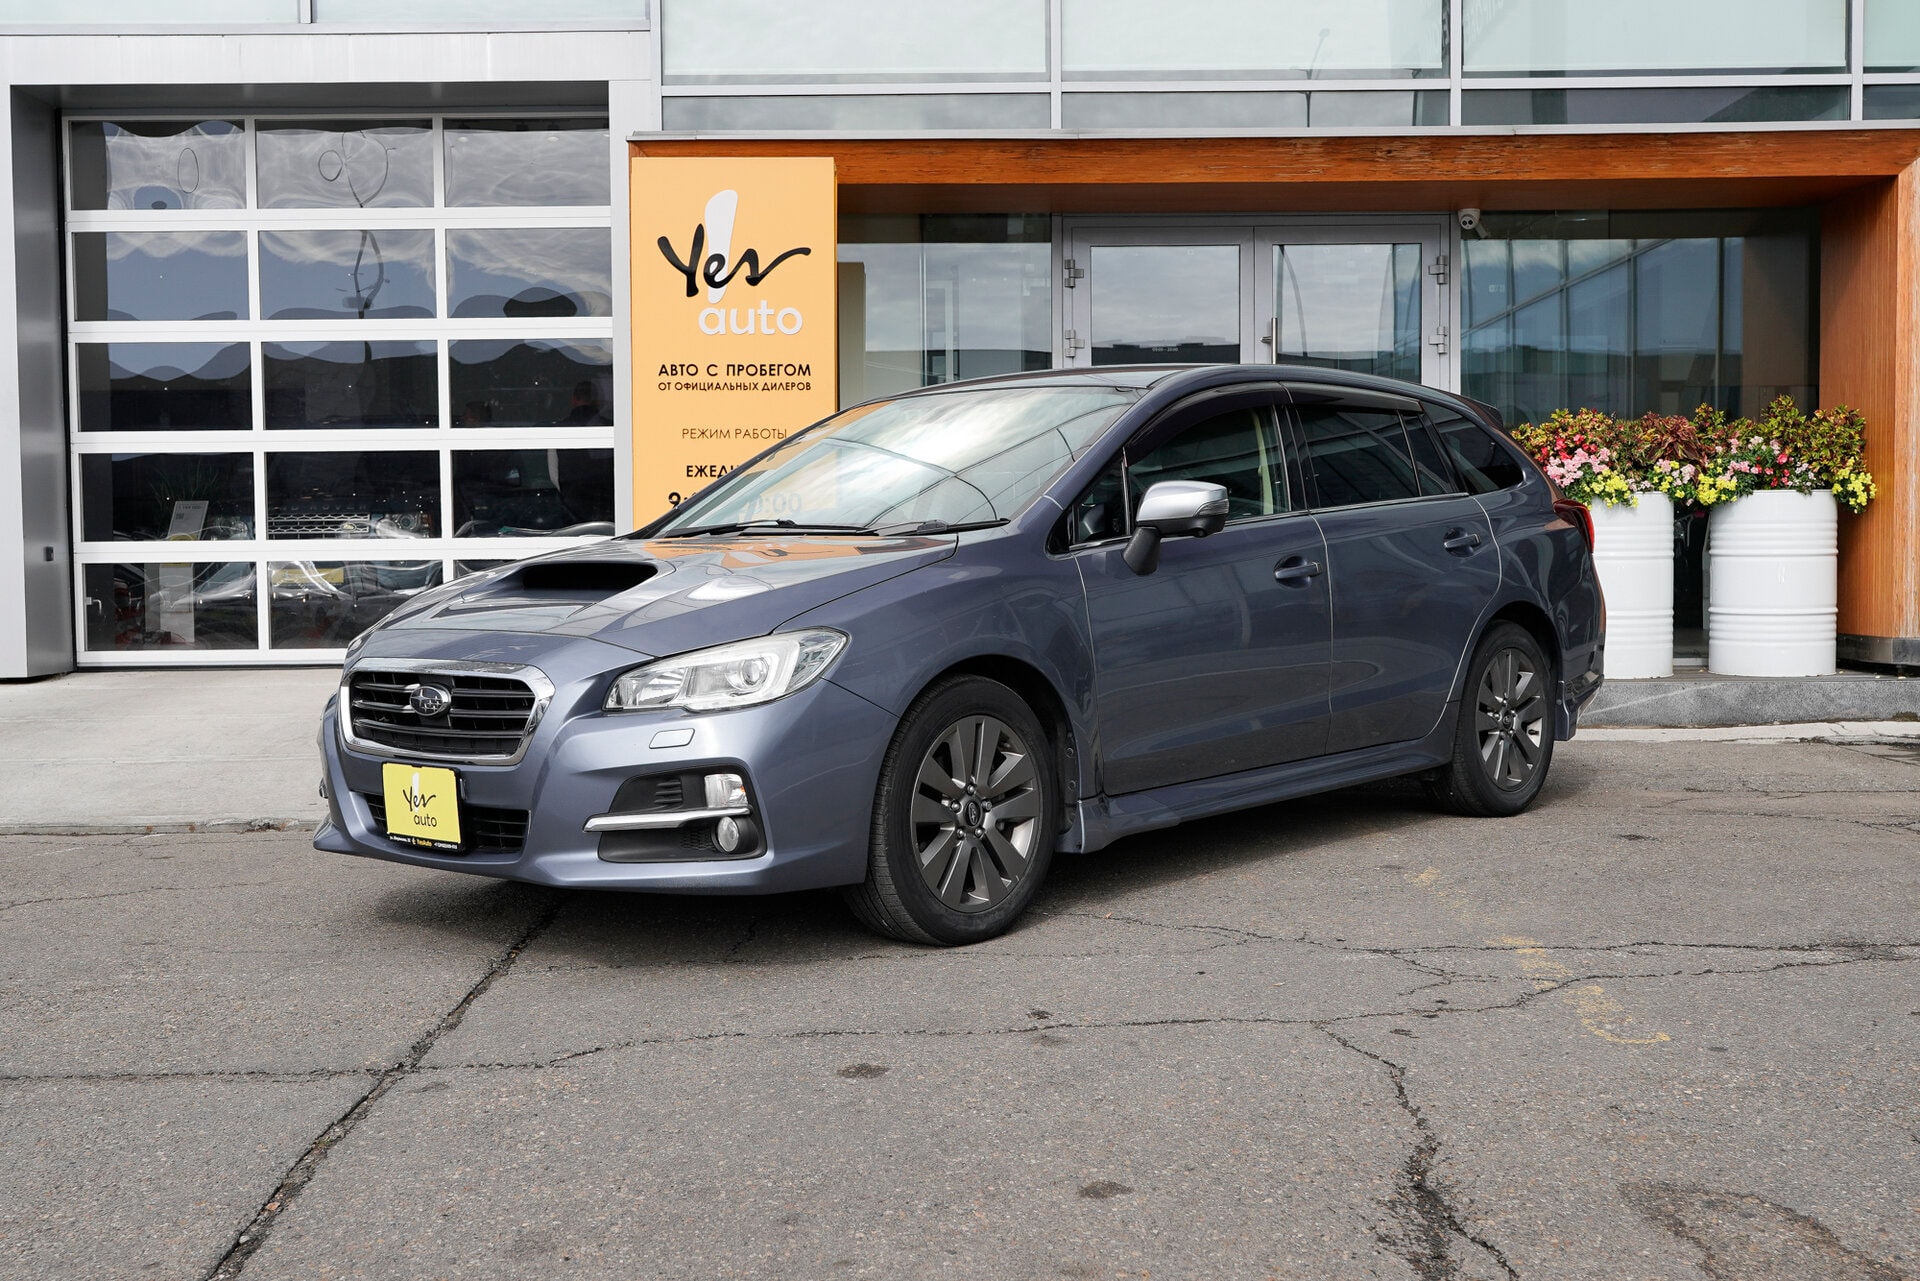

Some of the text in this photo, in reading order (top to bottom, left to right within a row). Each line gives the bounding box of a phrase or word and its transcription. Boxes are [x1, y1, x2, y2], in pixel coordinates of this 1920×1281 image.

[657, 223, 811, 297] Yes
[698, 299, 803, 335] auto
[658, 363, 811, 376] АВТО С ПРОБЕГОМ
[658, 382, 811, 392] ОТ ОФИЦИАЛЬНЫХ ДИЛЕРОВ
[682, 428, 787, 440] РЕЖИМ РАБОТЫ
[402, 786, 436, 812] Yes
[413, 814, 437, 828] auto
